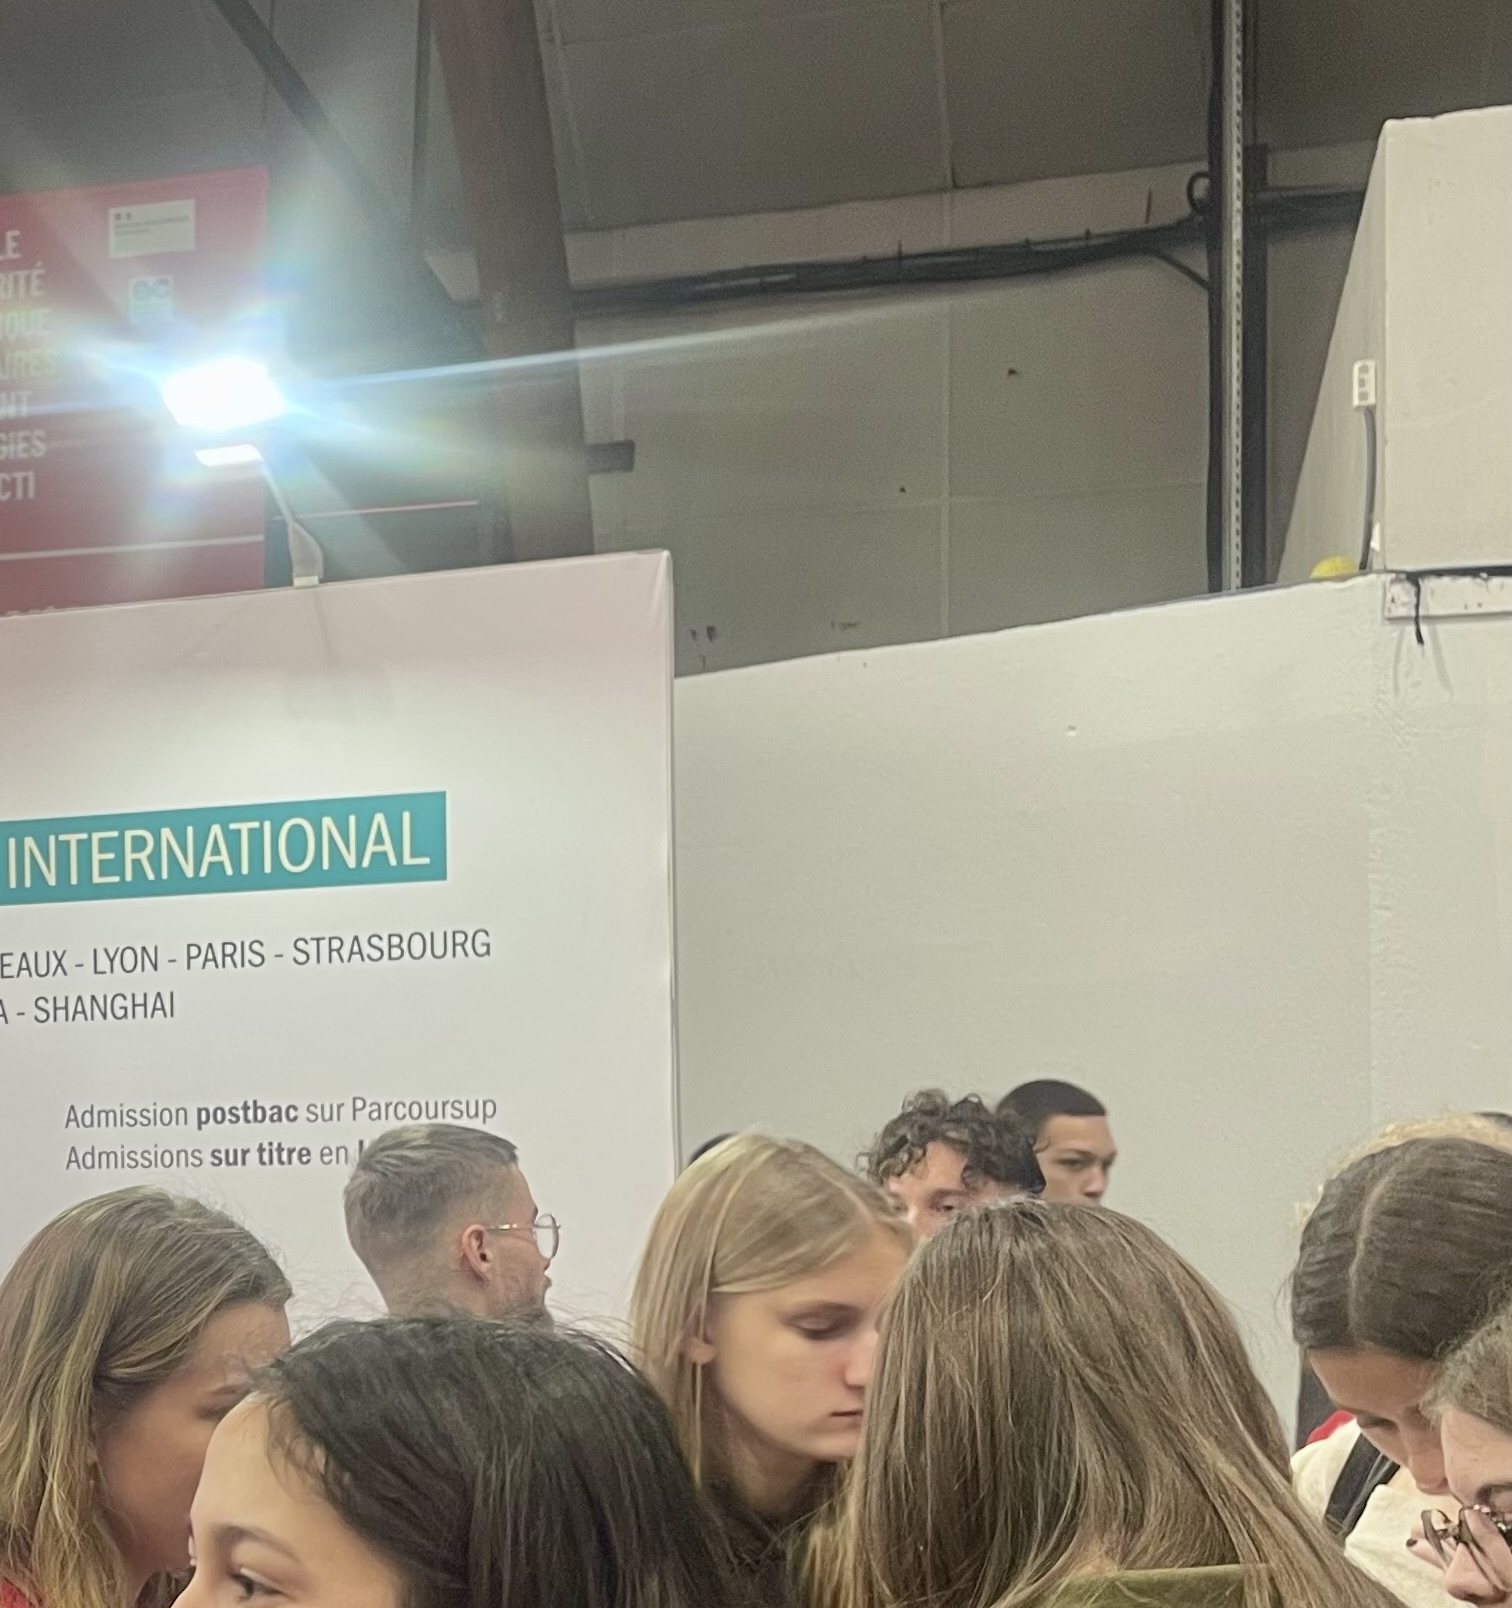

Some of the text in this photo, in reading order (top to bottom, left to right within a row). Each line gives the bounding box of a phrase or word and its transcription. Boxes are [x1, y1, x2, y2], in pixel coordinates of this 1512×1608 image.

[6, 810, 432, 891] INTERNATIONAL
[91, 945, 160, 978] LYON
[185, 938, 267, 972] PARIS
[291, 929, 492, 968] STRASBOURG
[33, 991, 176, 1025] SHANGHAI
[64, 1096, 498, 1131] Admission postbac sur Parcoursup
[65, 1144, 204, 1170] Admissions
[209, 1144, 251, 1168] sur
[256, 1141, 312, 1167] titre
[319, 1144, 350, 1167] en
